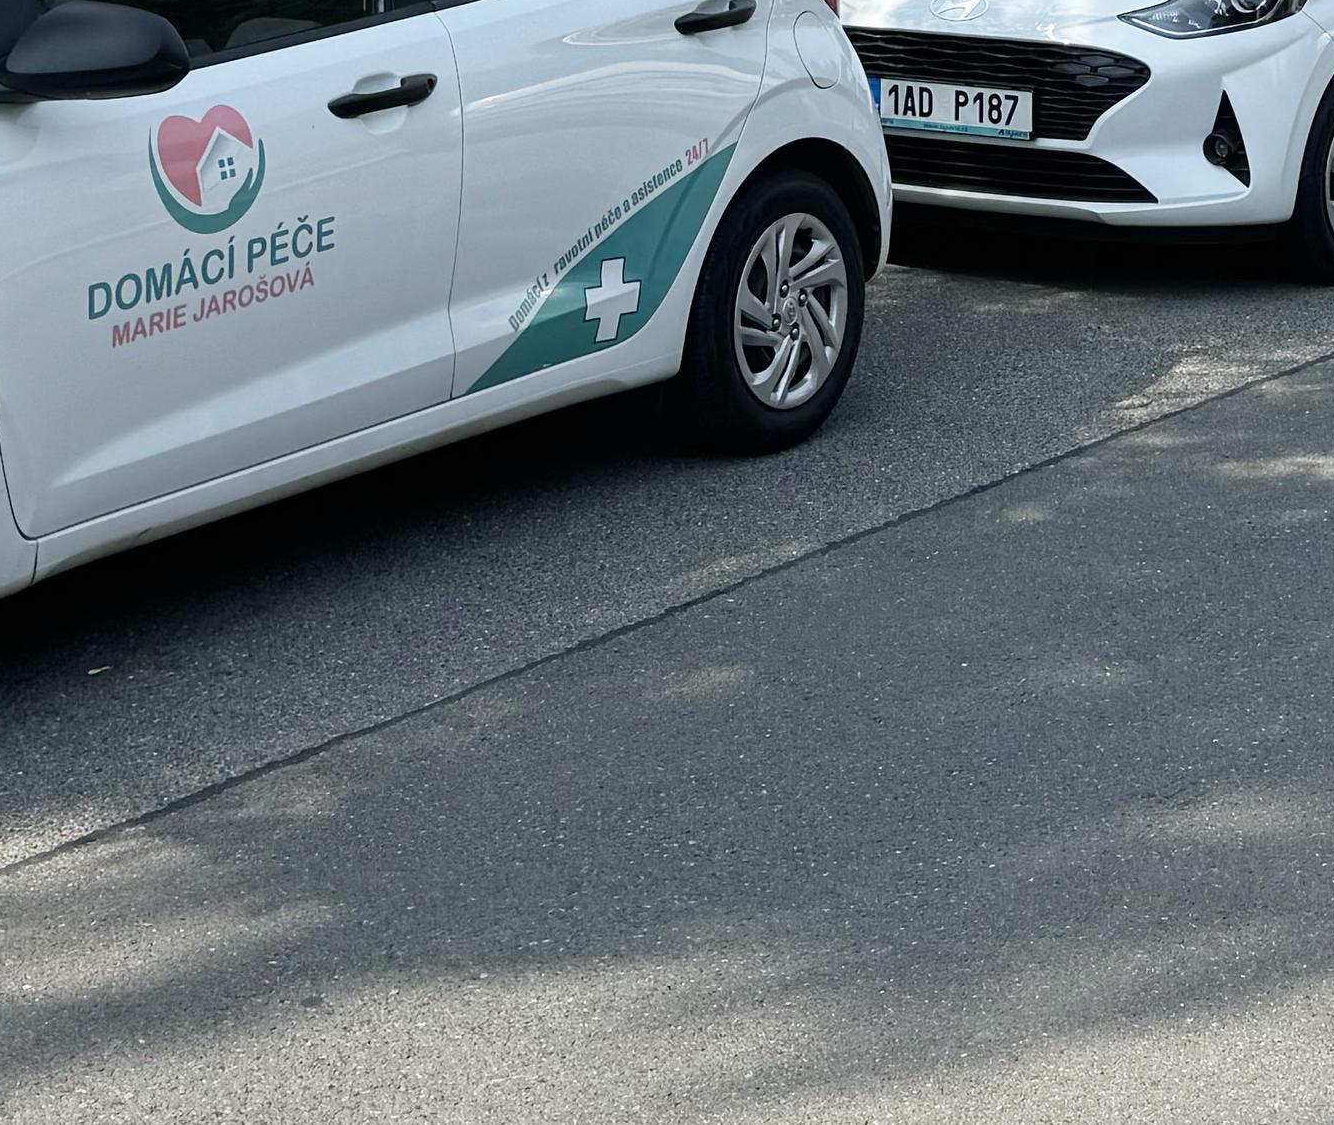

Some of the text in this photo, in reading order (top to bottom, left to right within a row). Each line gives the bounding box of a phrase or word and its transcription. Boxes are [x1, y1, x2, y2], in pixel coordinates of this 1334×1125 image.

[888, 84, 1019, 126] 1AD P187
[622, 199, 632, 214] a
[630, 158, 684, 207] asistence
[685, 138, 710, 166] 24/7
[87, 214, 336, 321] DOMÁCÍ PÉČE
[111, 261, 315, 348] MARIE JAROŠOVÁ
